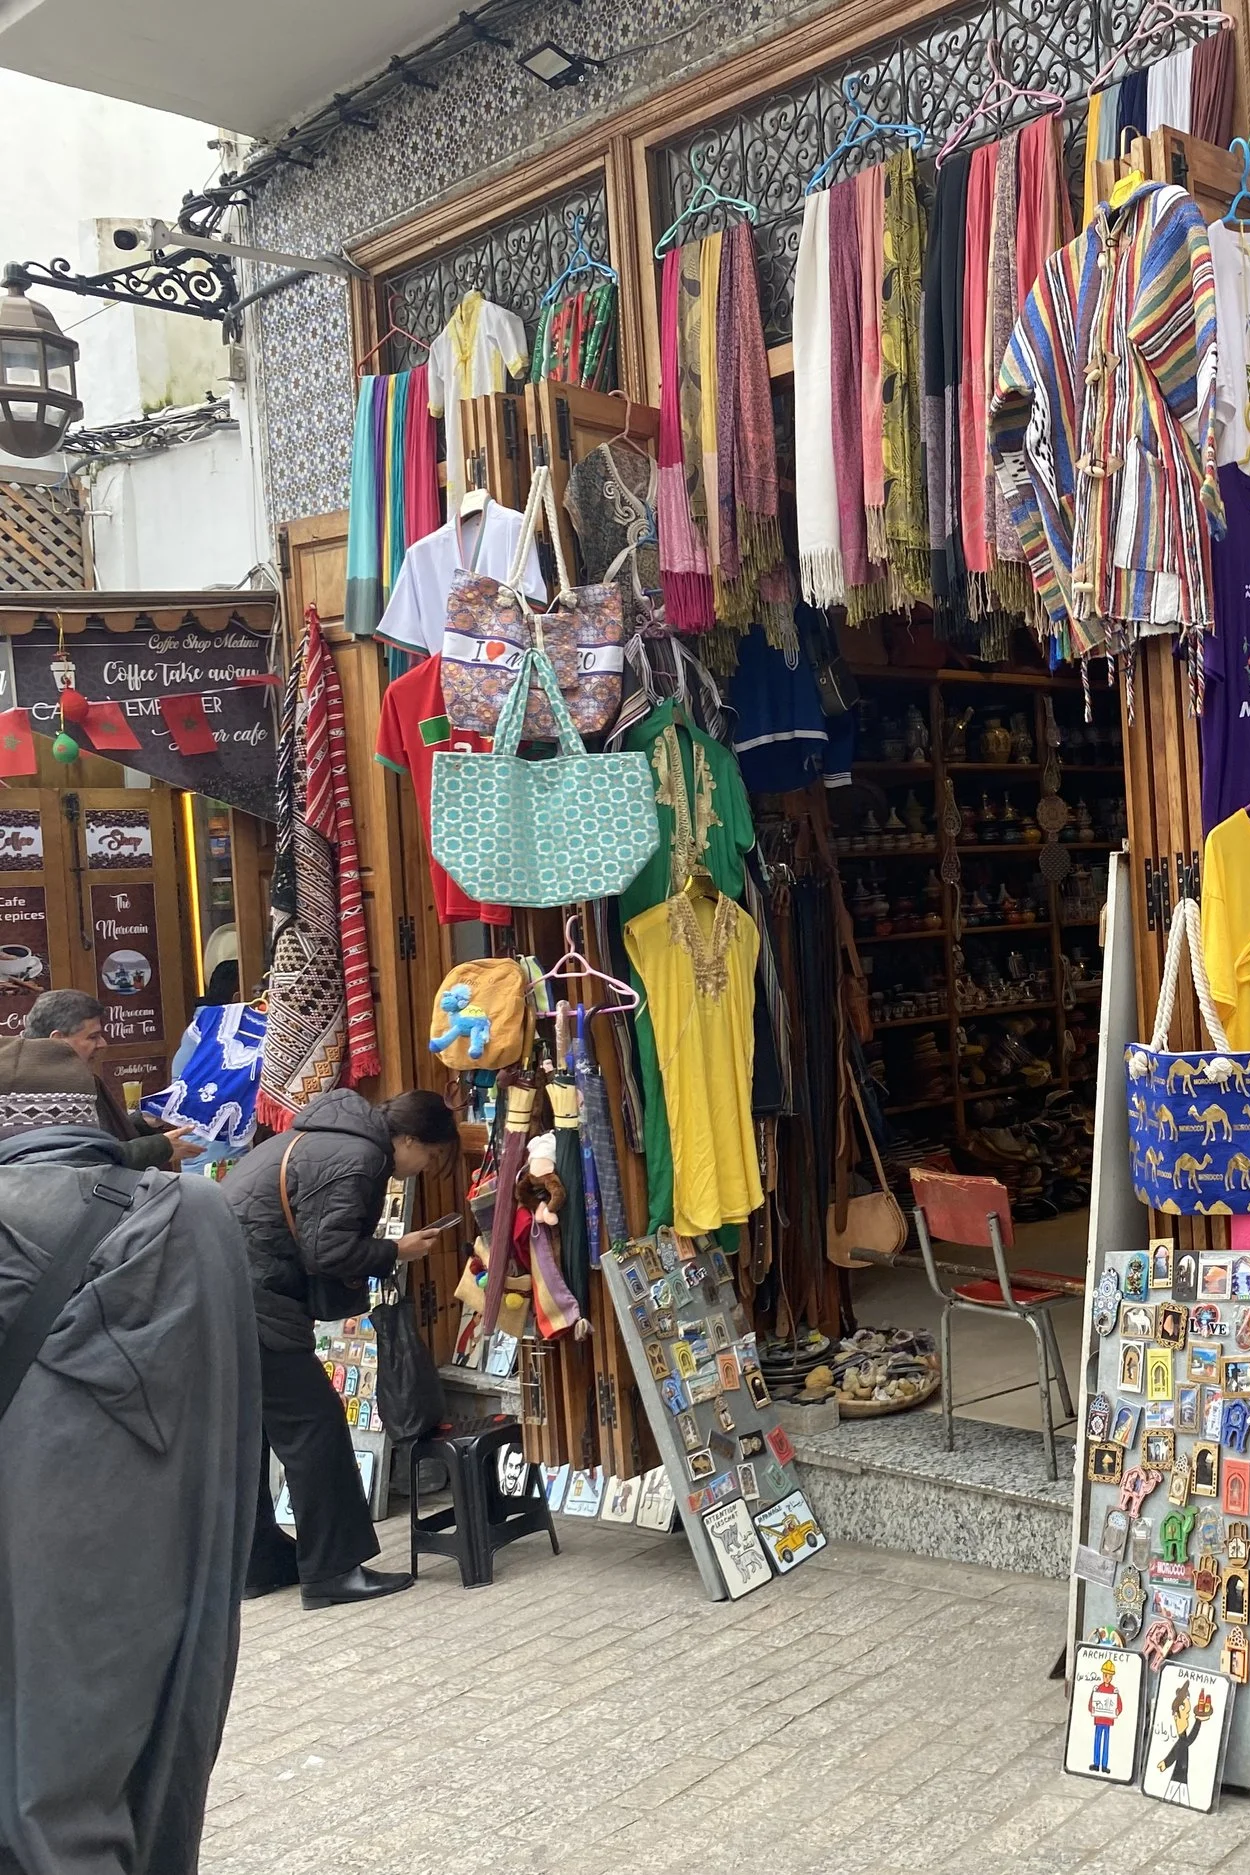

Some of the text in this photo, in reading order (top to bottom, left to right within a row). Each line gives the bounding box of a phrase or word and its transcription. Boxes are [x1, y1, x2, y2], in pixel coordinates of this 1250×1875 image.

[148, 634, 259, 654] Coffee Shop Medina
[103, 661, 158, 691] Coffee
[156, 661, 204, 687] Take
[233, 722, 268, 746] cafe
[98, 828, 143, 852] Shop
[4, 911, 46, 922] epices
[95, 919, 149, 940] Marocain
[104, 1022, 134, 1039] Mint
[1082, 1649, 1131, 1662] ARCHITECT
[1178, 1669, 1217, 1685] BARMAN
